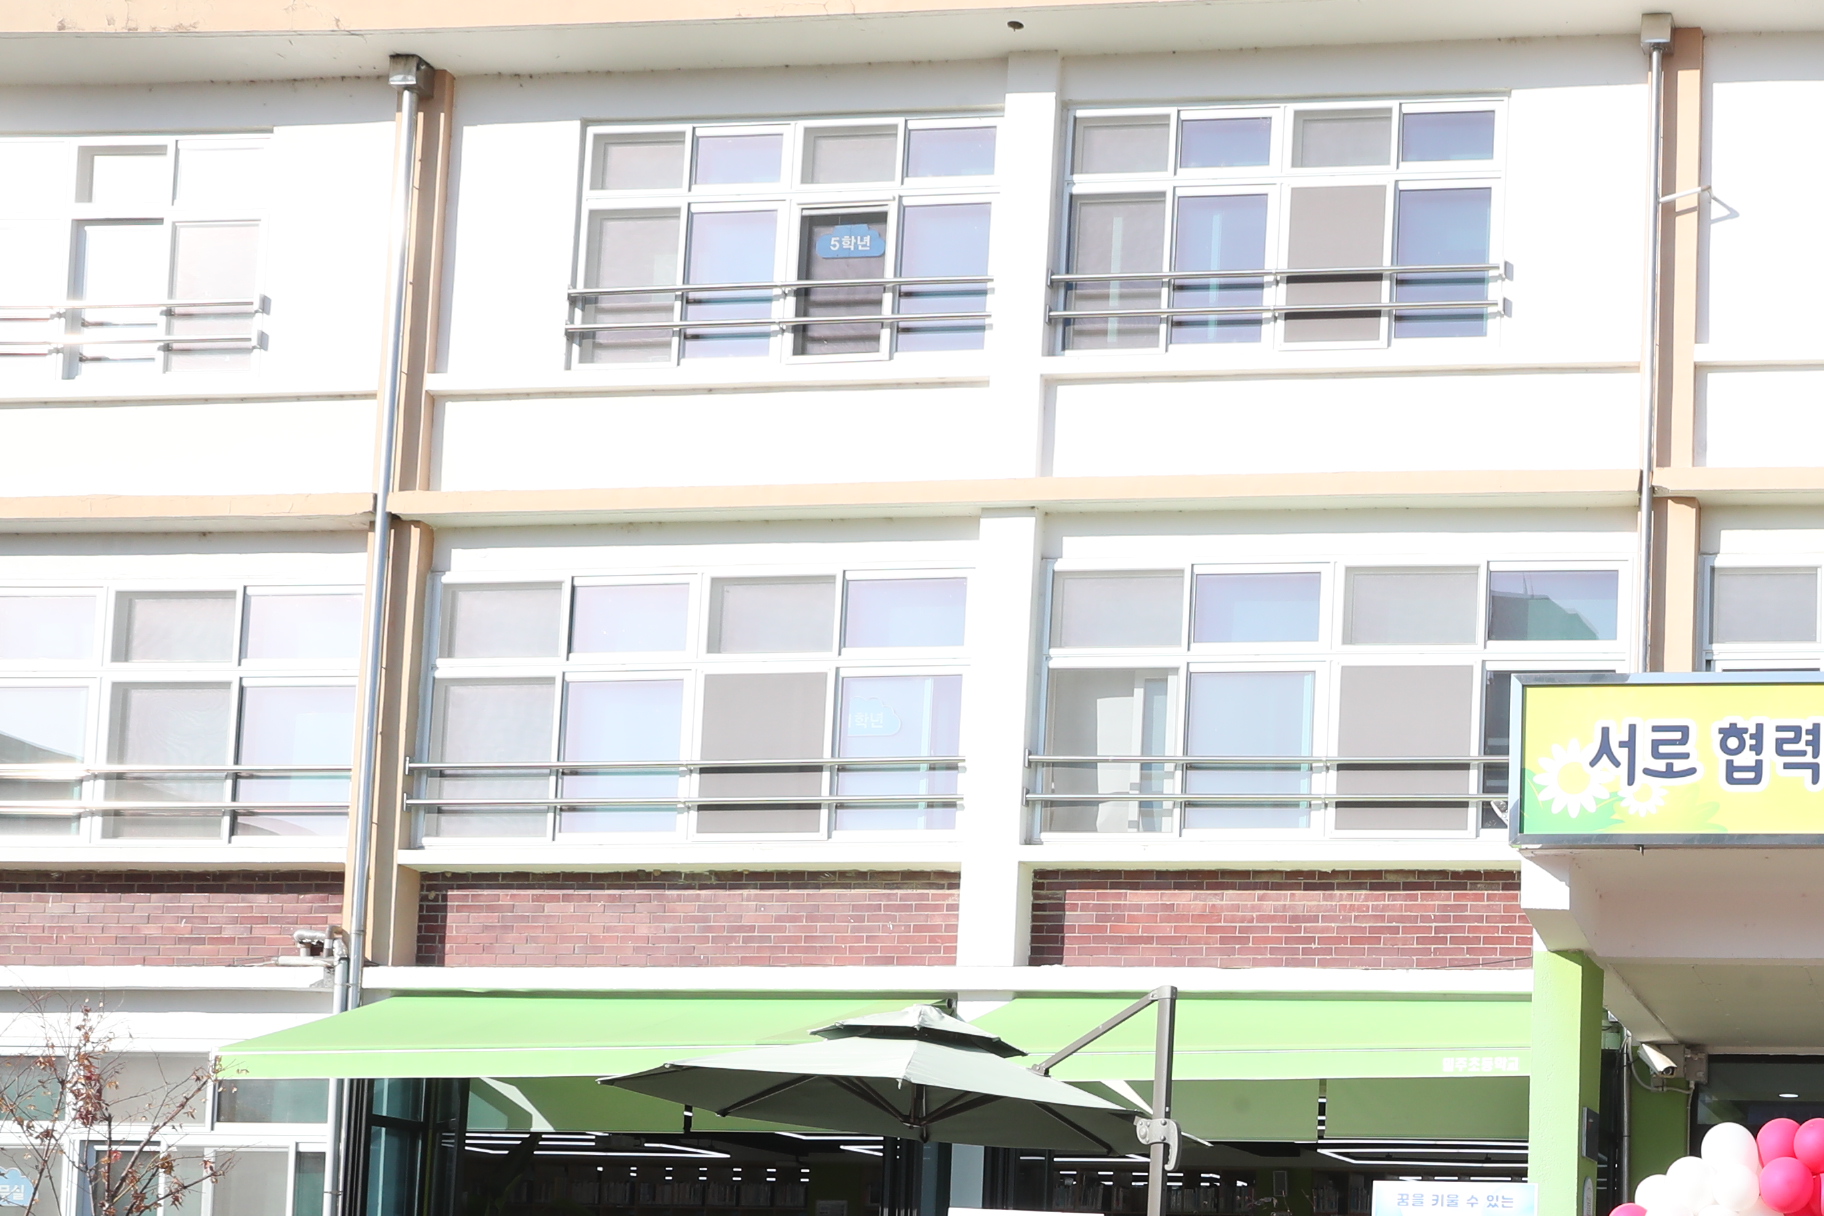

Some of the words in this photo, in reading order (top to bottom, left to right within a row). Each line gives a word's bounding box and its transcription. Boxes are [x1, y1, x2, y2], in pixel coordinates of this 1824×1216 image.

[830, 235, 871, 251] 5학년
[1588, 721, 1698, 787] 서로
[1396, 1193, 1424, 1207] 꿈을
[1431, 1193, 1459, 1208] 키울
[1466, 1195, 1479, 1208] 수
[1486, 1194, 1514, 1208] 있는
